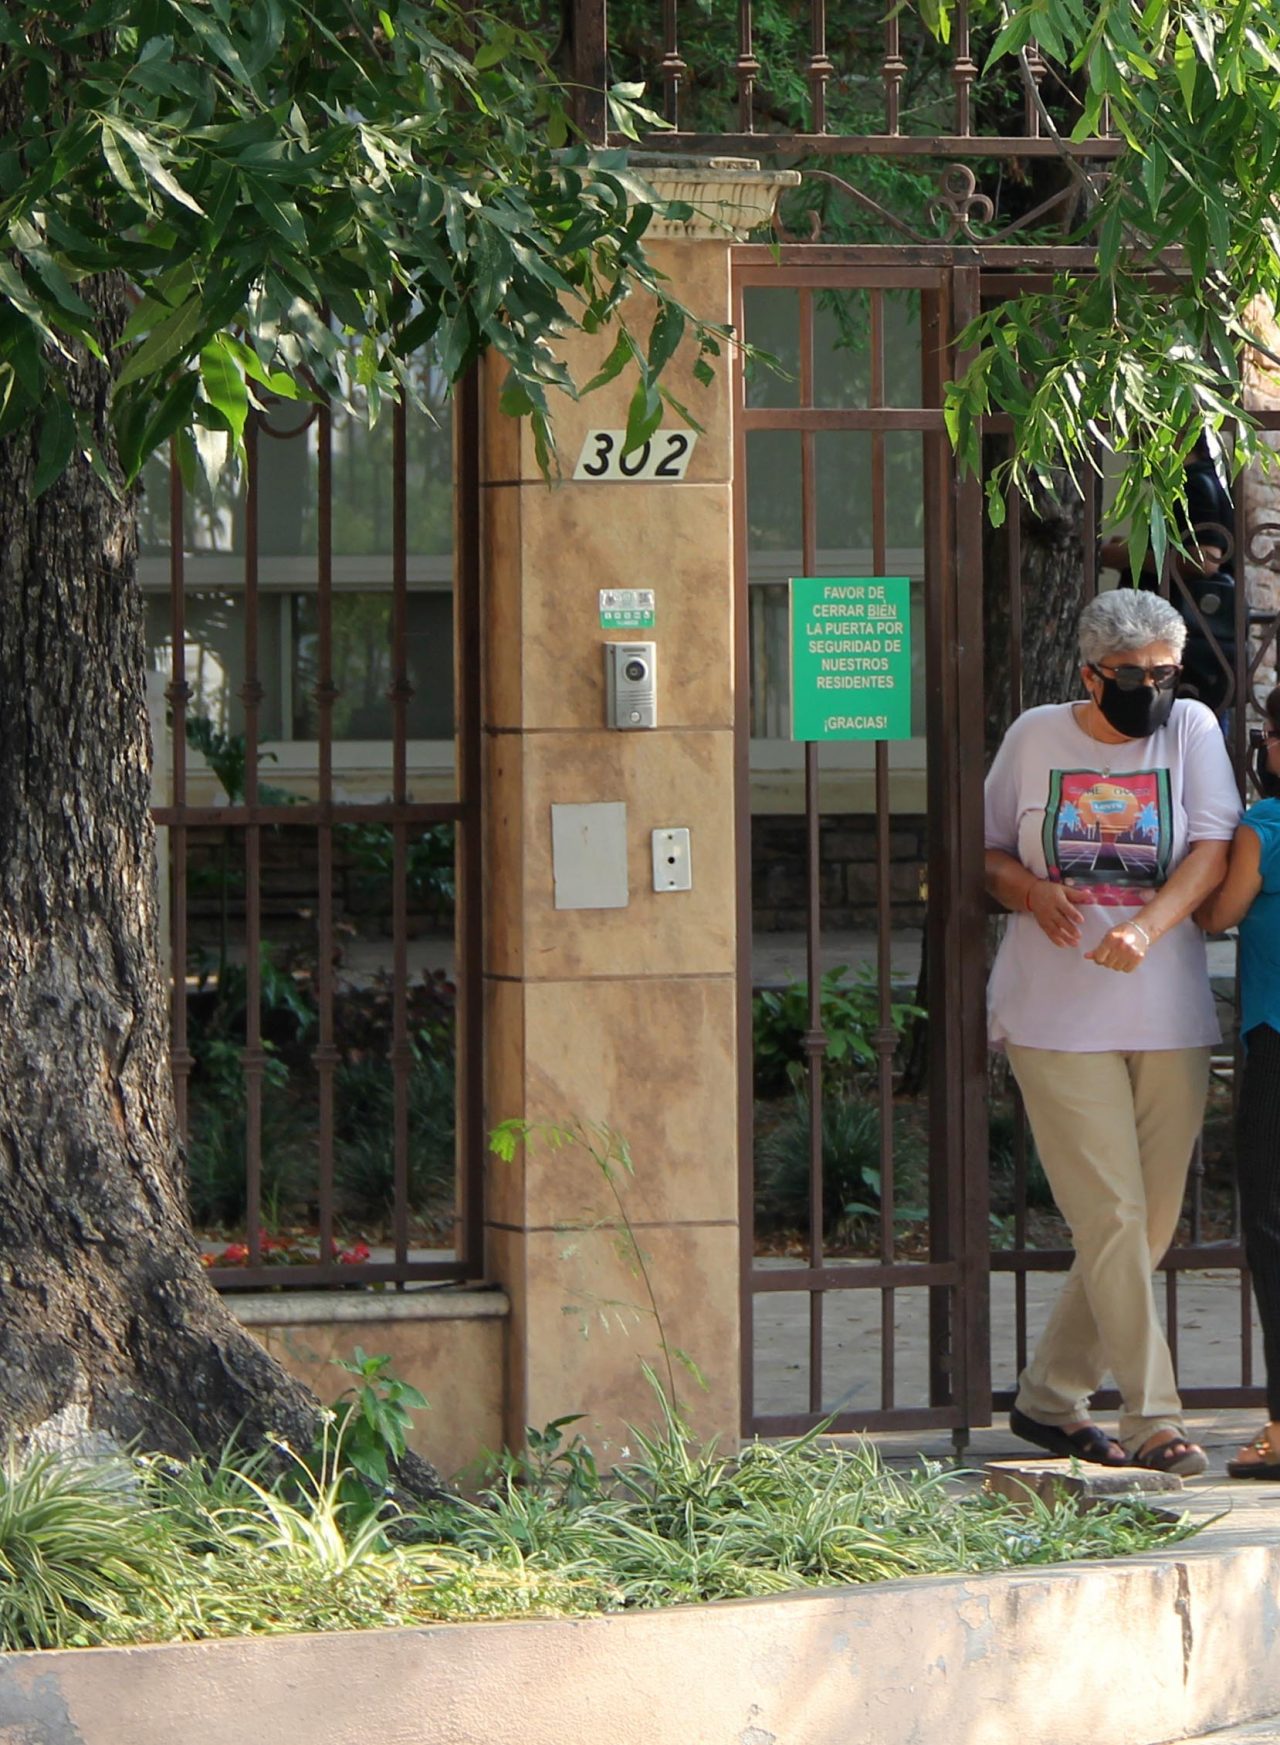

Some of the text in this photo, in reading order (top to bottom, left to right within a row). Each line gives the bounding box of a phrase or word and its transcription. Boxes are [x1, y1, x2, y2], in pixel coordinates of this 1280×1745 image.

[583, 433, 688, 476] 302
[824, 586, 885, 599] FAVOR DE
[812, 604, 864, 617] CERRAR
[806, 622, 903, 635] LA PUERTA POR
[808, 640, 902, 653] SEGURIDAD DE
[821, 658, 889, 671] NUESTROS
[817, 675, 895, 689] RESIDENTES
[824, 716, 888, 732] ¡GRACIAS!
